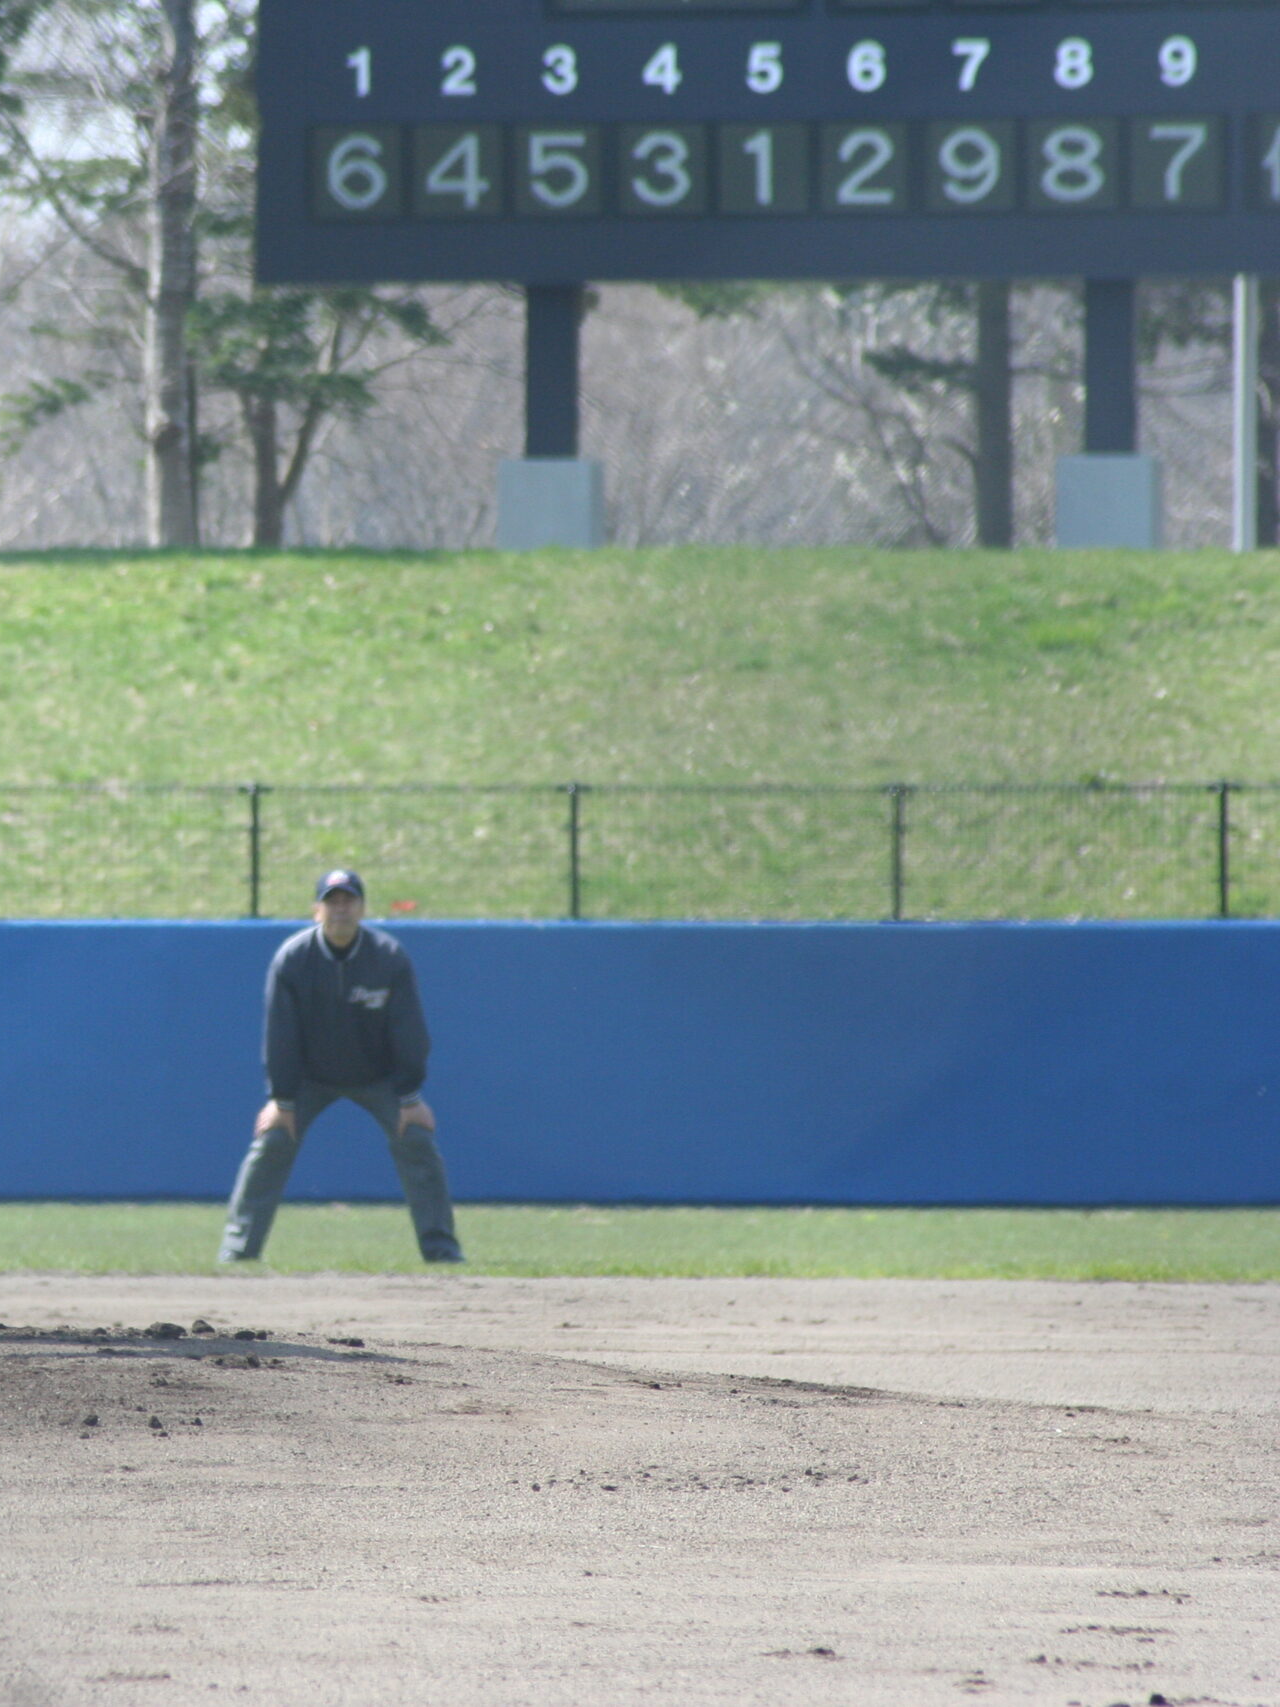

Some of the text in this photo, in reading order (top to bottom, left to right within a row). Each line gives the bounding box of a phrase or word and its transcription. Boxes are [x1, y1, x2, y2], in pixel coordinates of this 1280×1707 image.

[348, 35, 1197, 95] 1 2 3 4 5 6 7 8 9
[327, 134, 387, 208] 6
[425, 133, 489, 207] 4
[528, 131, 589, 207] 5
[631, 130, 691, 206] 3
[742, 129, 773, 206] 1
[835, 127, 894, 205] 2
[937, 125, 1001, 204] 9
[1039, 124, 1105, 203] 8
[1148, 122, 1208, 201] 7
